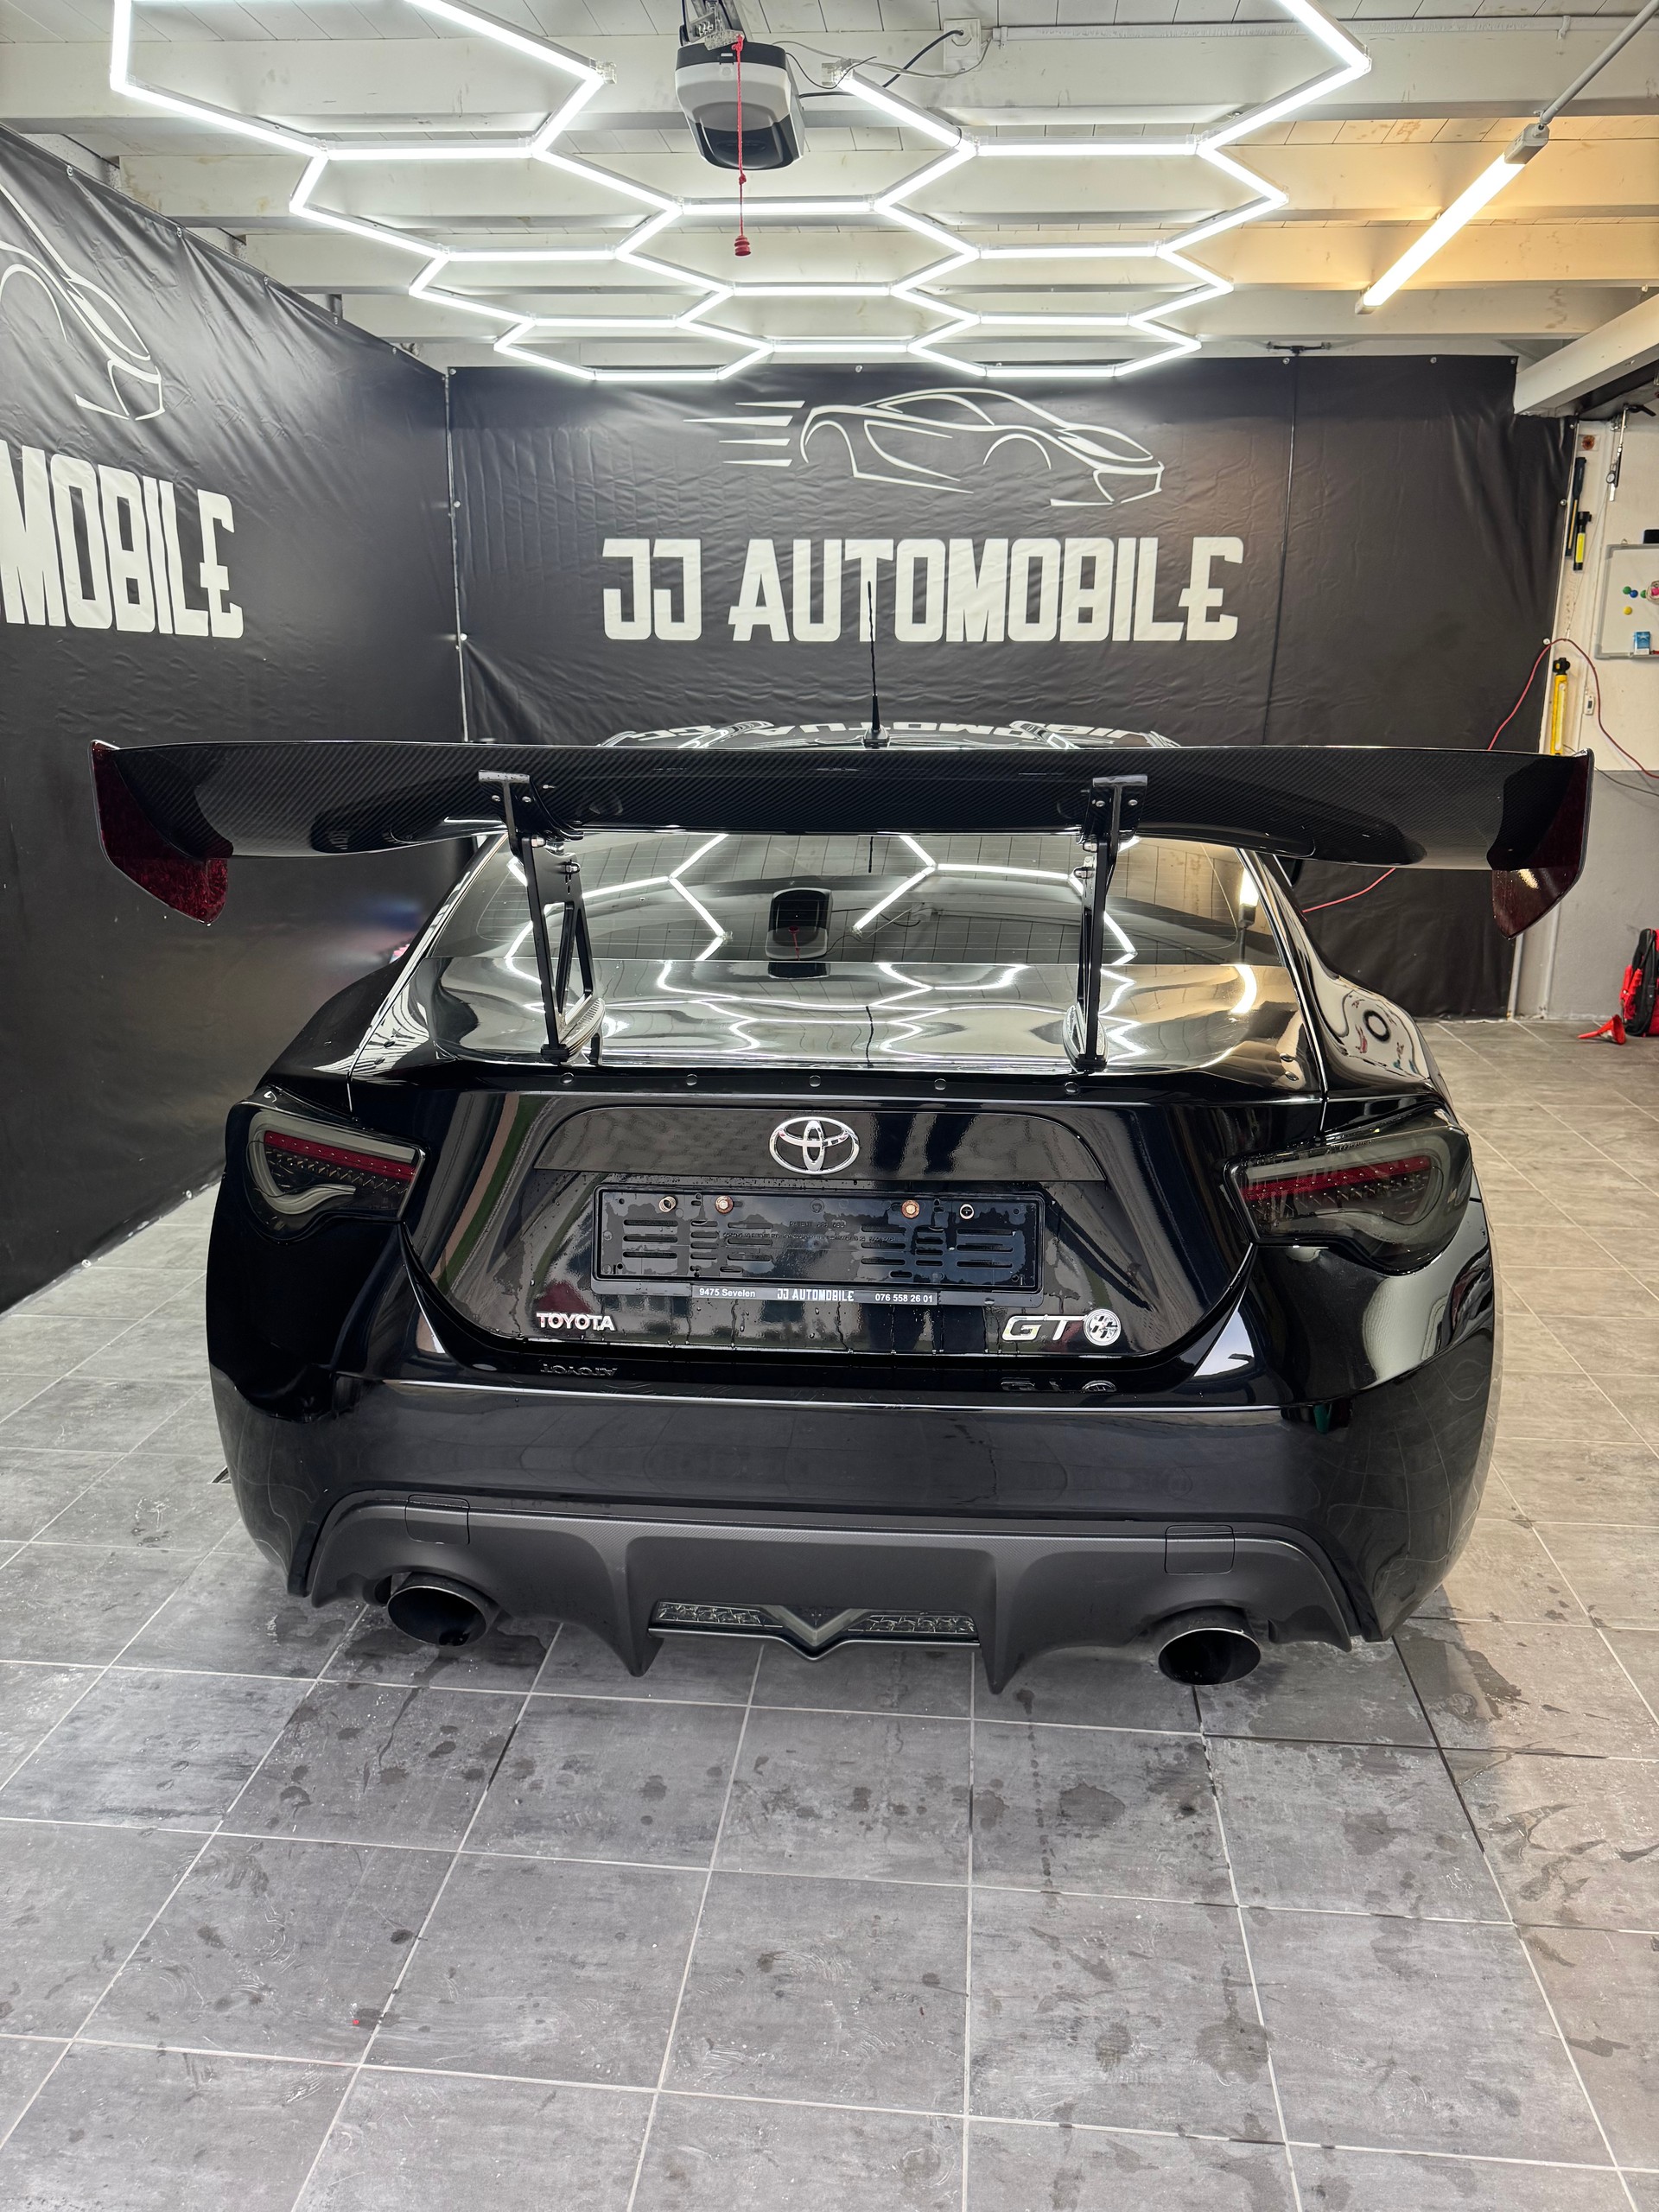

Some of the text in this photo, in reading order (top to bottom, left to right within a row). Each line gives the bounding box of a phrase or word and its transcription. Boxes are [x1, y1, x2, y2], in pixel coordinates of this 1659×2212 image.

[602, 537, 1244, 642] JJ AUTOMOBILE
[699, 1287, 720, 1296] 9475
[721, 1289, 756, 1298] Sevelen
[791, 1288, 855, 1302] AUTOMOBILE
[874, 1293, 891, 1301] 076
[910, 1294, 921, 1303] 26
[923, 1294, 934, 1303] 01
[536, 1313, 616, 1332] TOYOTA
